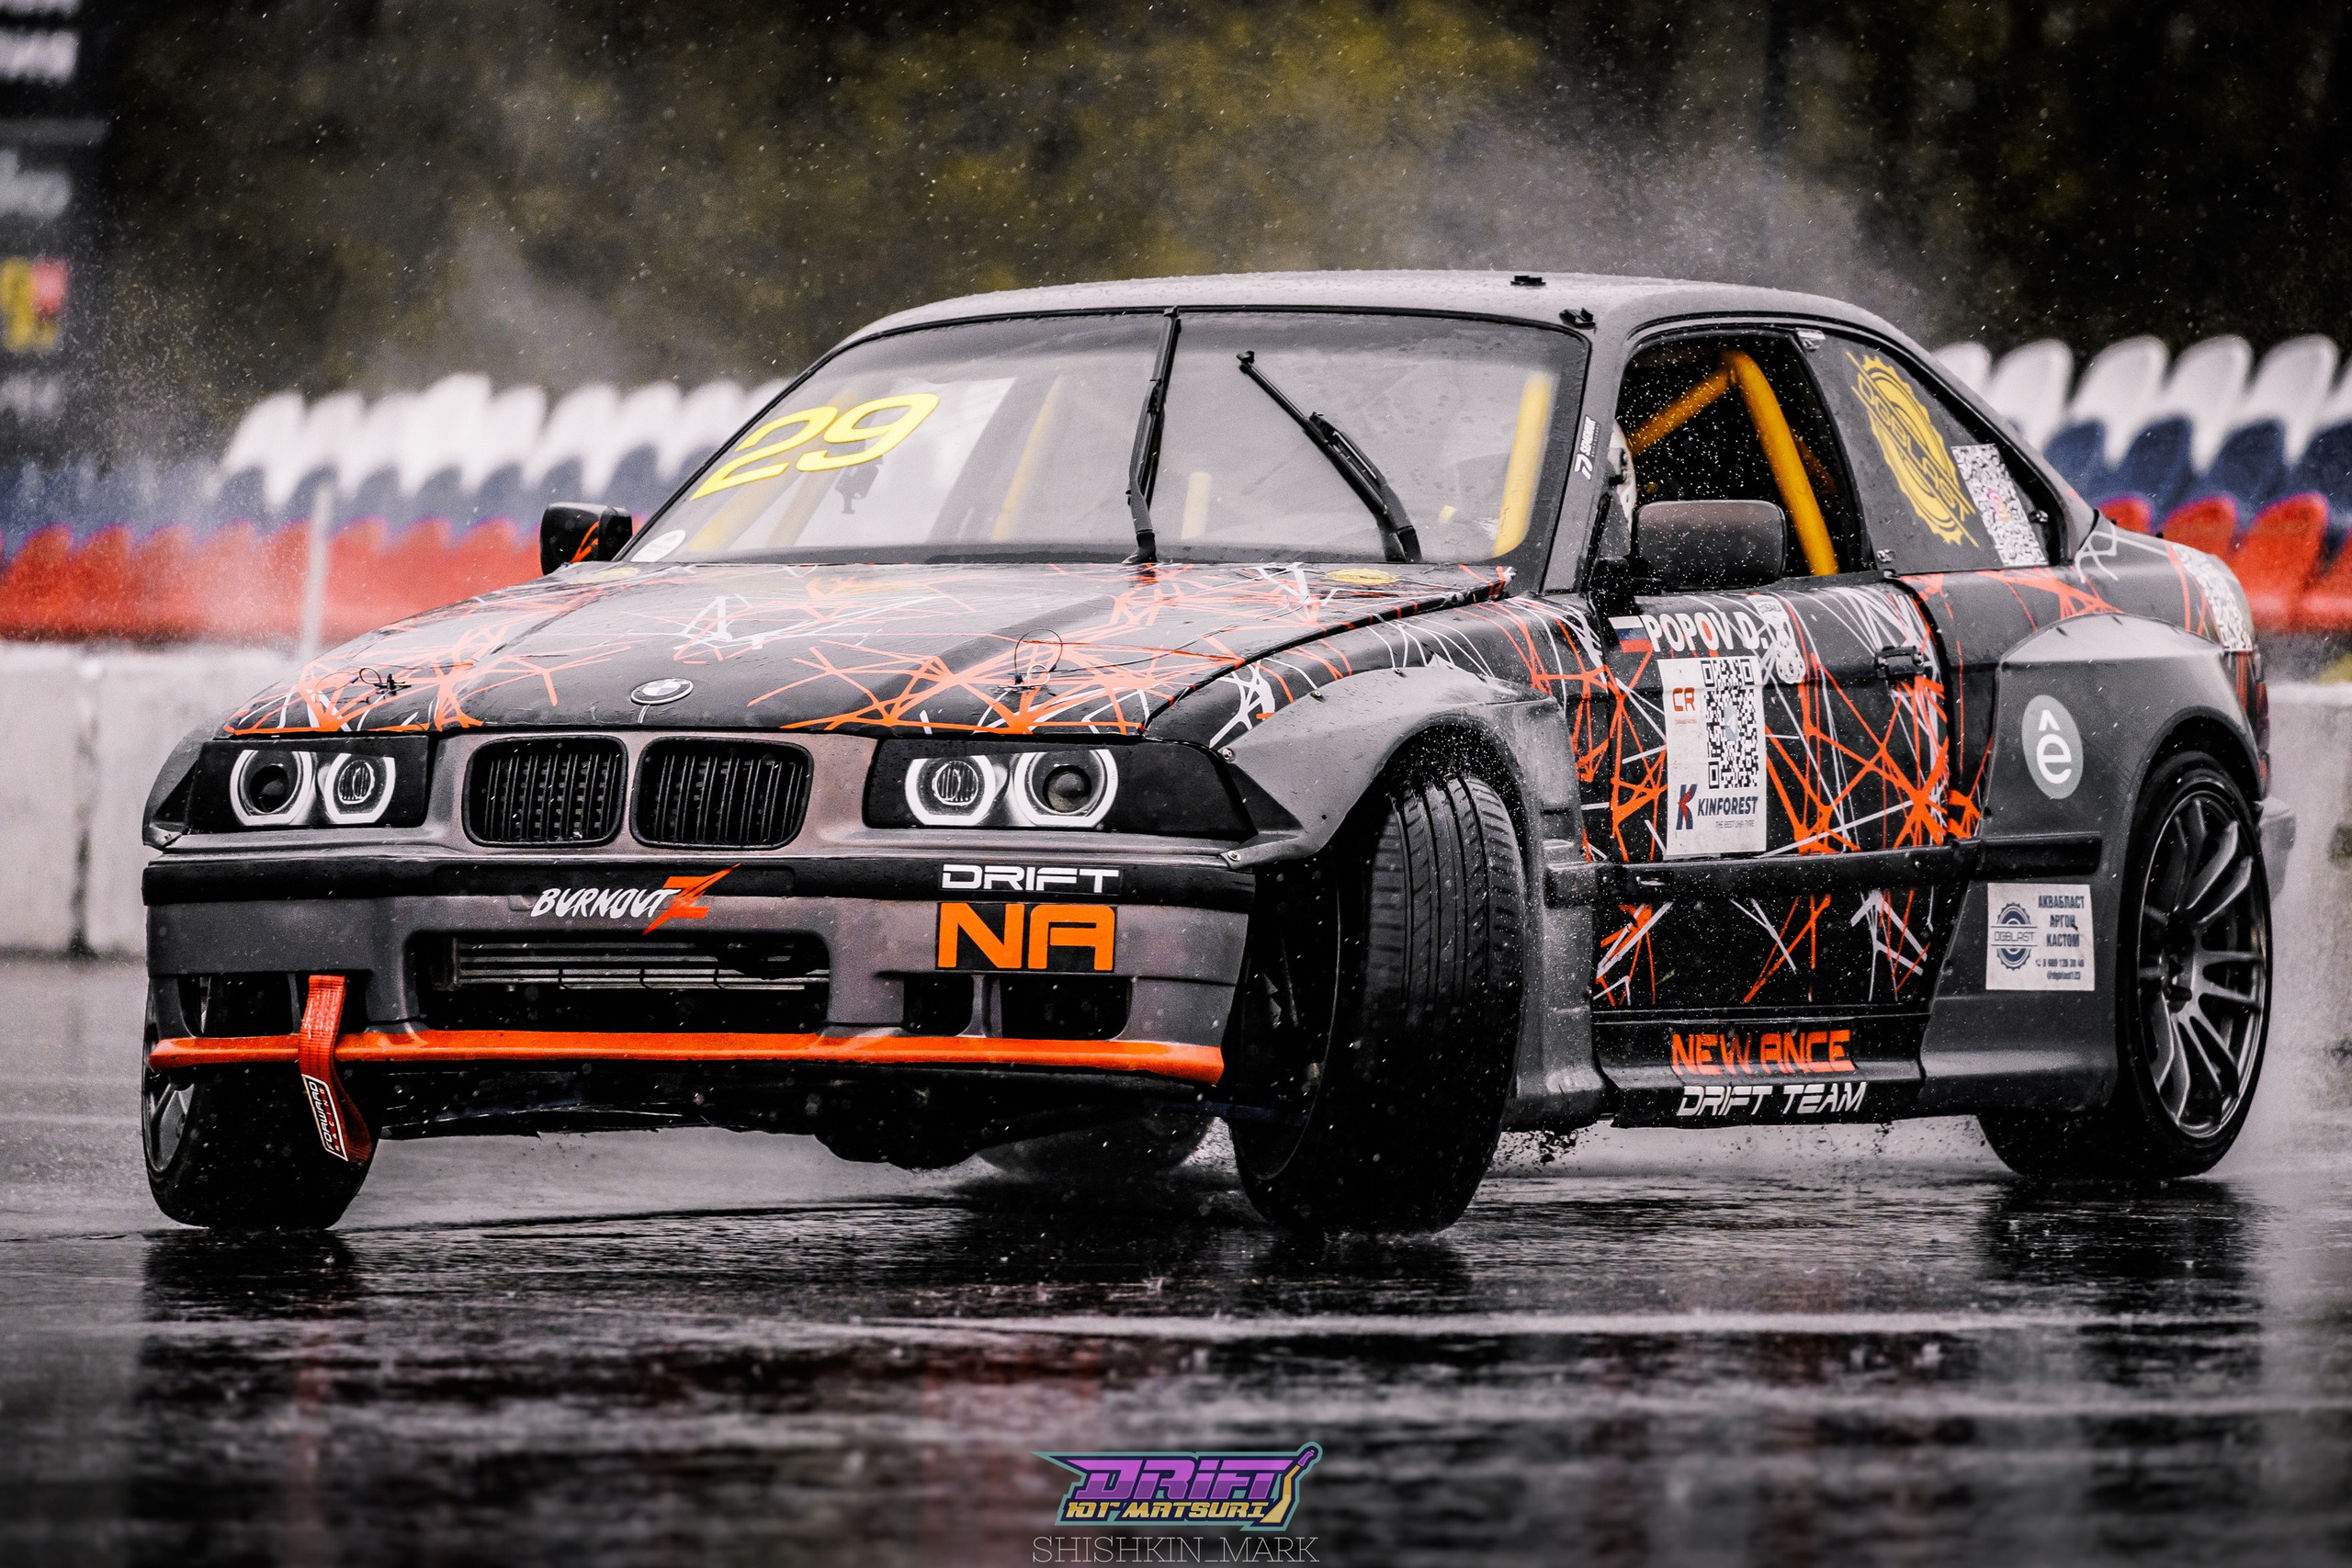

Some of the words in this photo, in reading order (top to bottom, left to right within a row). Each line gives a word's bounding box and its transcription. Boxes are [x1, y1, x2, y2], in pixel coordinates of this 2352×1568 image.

[690, 393, 939, 501] 29
[1640, 612, 1734, 652] POPOV
[1738, 612, 1769, 649] D.
[1673, 687, 1695, 712] CR
[1697, 796, 1758, 816] KINFOREST
[942, 863, 1119, 893] DRIFT
[2038, 896, 2085, 908] АКВАБЛАСТ
[937, 902, 1115, 971] NA
[2050, 914, 2075, 928] АРГОН
[2046, 933, 2080, 947] КАСТОМ
[1677, 1085, 1773, 1116] DRIFT
[1782, 1082, 1867, 1115] TEAM
[308, 1081, 334, 1150] FORWARD
[319, 1088, 340, 1152] RACING
